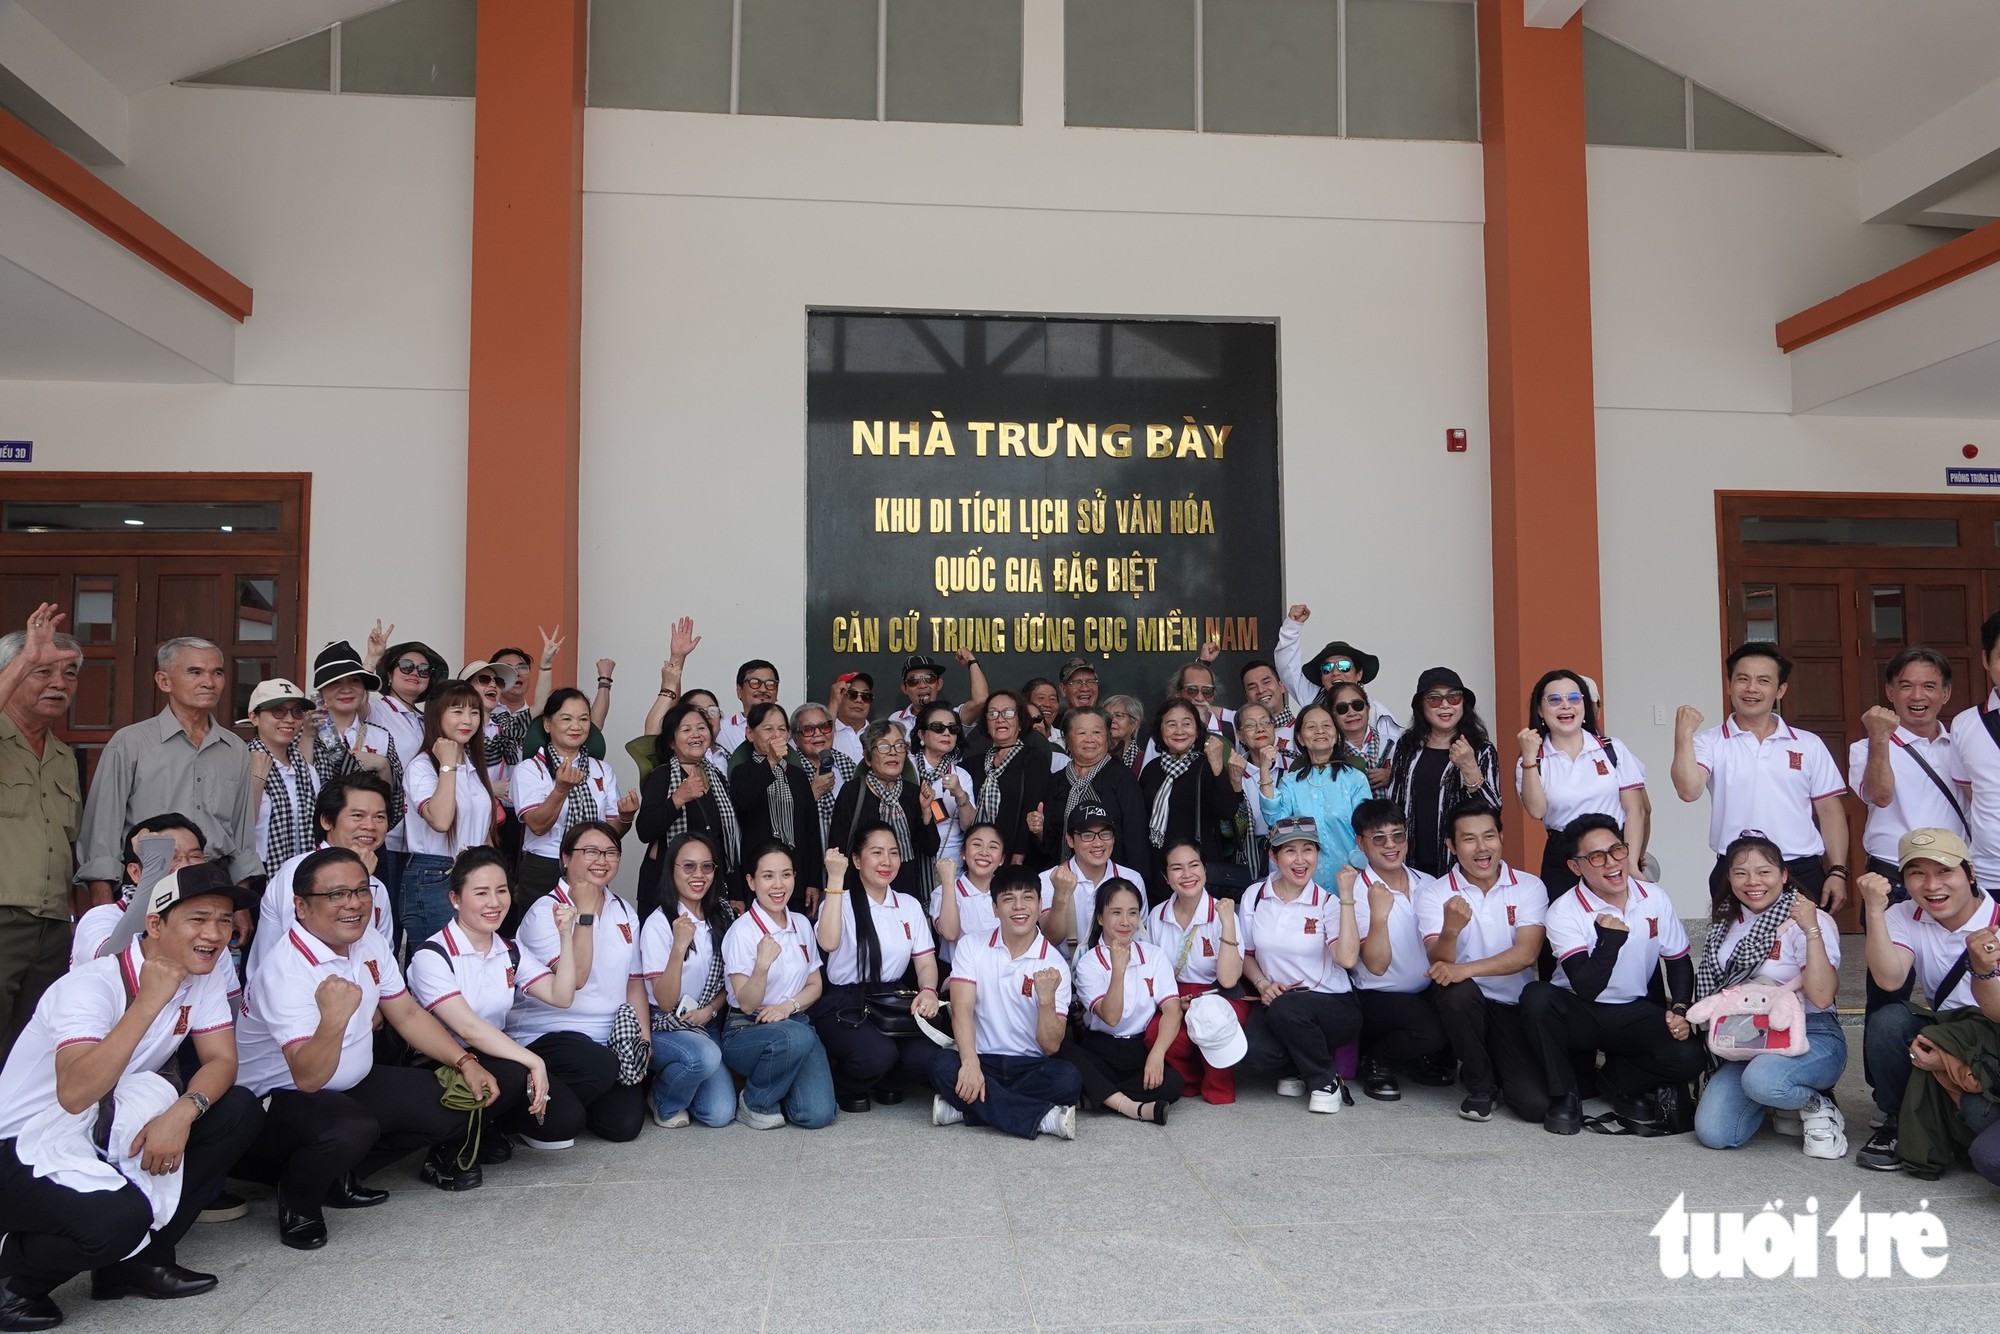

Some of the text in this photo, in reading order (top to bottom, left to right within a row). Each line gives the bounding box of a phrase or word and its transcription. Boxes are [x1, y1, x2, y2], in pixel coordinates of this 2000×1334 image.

[15, 447, 26, 459] 3D
[852, 411, 1233, 459] NHÀ TRƯNG BÀY
[875, 488, 1215, 541] KHU DI TÍCH LỊCH SỬ VĂN HÓA
[934, 546, 1158, 600] QUỐC GIA ĐẶC BIỆT
[832, 608, 1259, 660] CĂN CỨ TRUNG ƯƠNG CỤC MIỀN NAM
[279, 683, 292, 694] T
